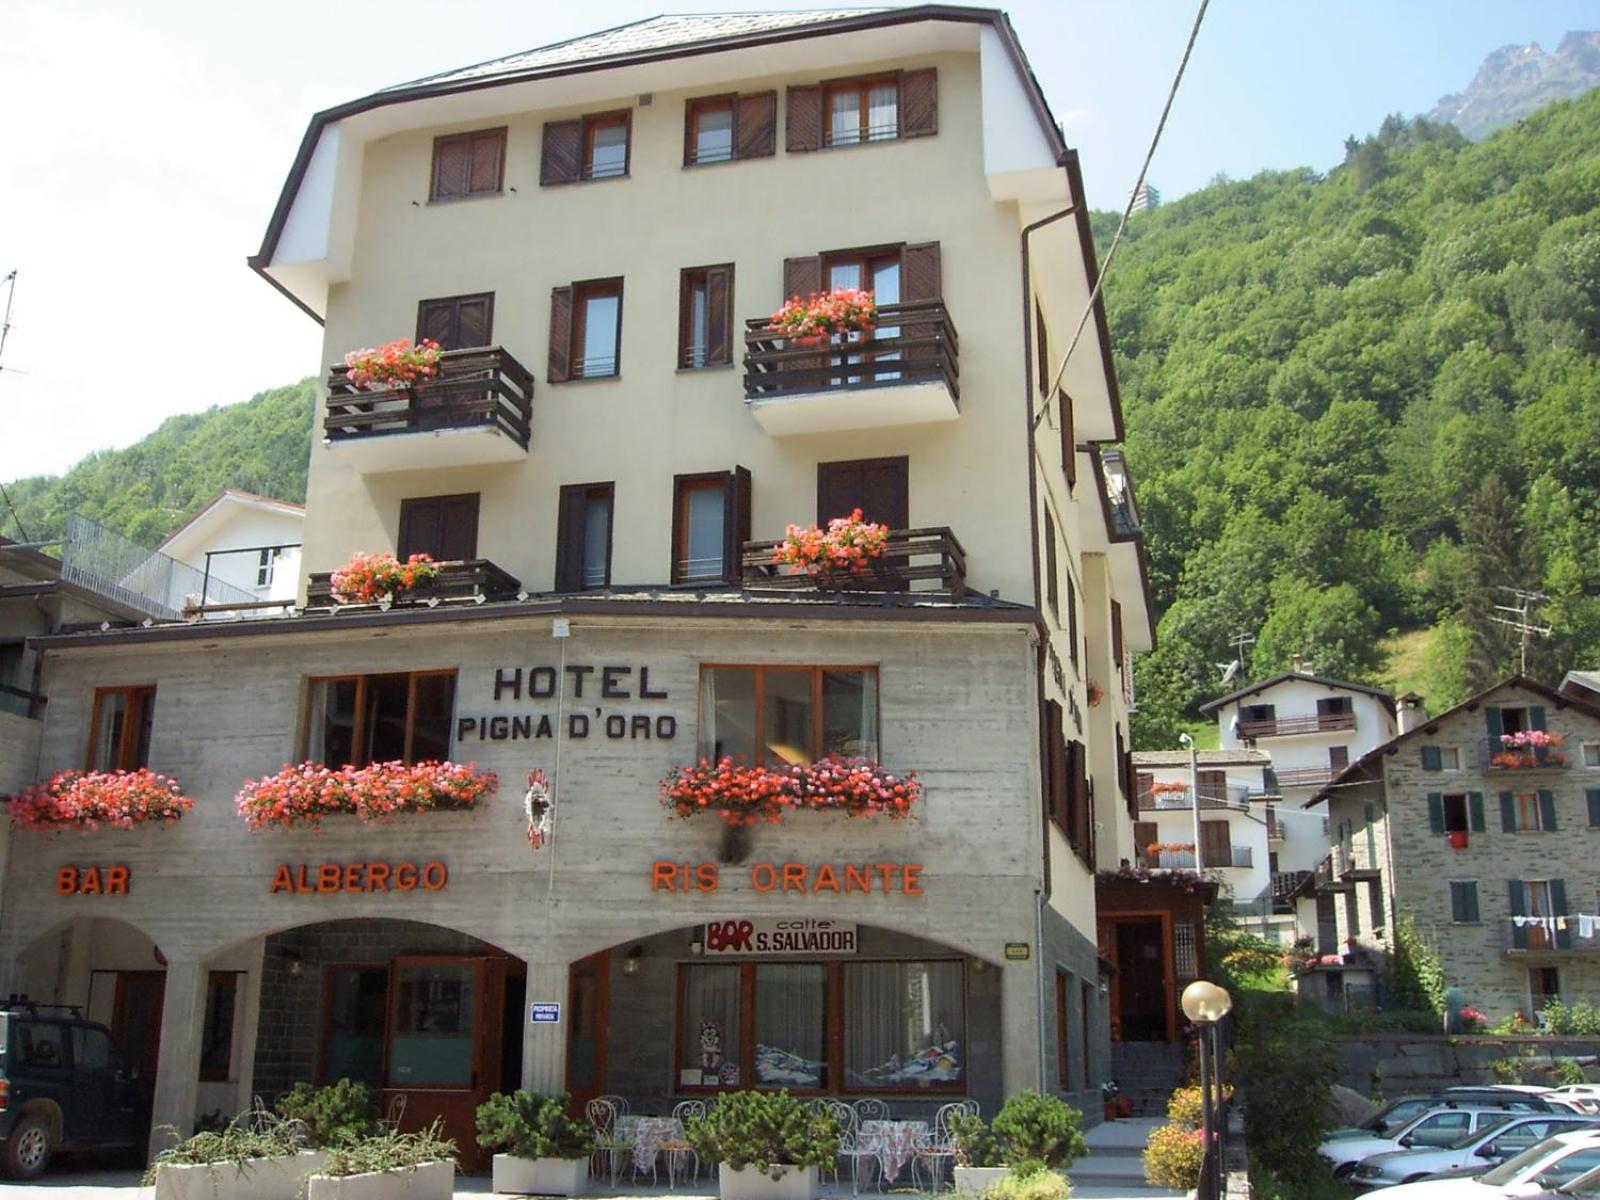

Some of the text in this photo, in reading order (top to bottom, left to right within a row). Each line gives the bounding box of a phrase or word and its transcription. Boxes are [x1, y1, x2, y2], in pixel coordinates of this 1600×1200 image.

[494, 665, 668, 700] HOTEL
[457, 708, 677, 742] PIGNA D'ORO
[55, 865, 131, 896] BAR
[269, 861, 449, 894] ALBERGO
[707, 920, 754, 952] BAR
